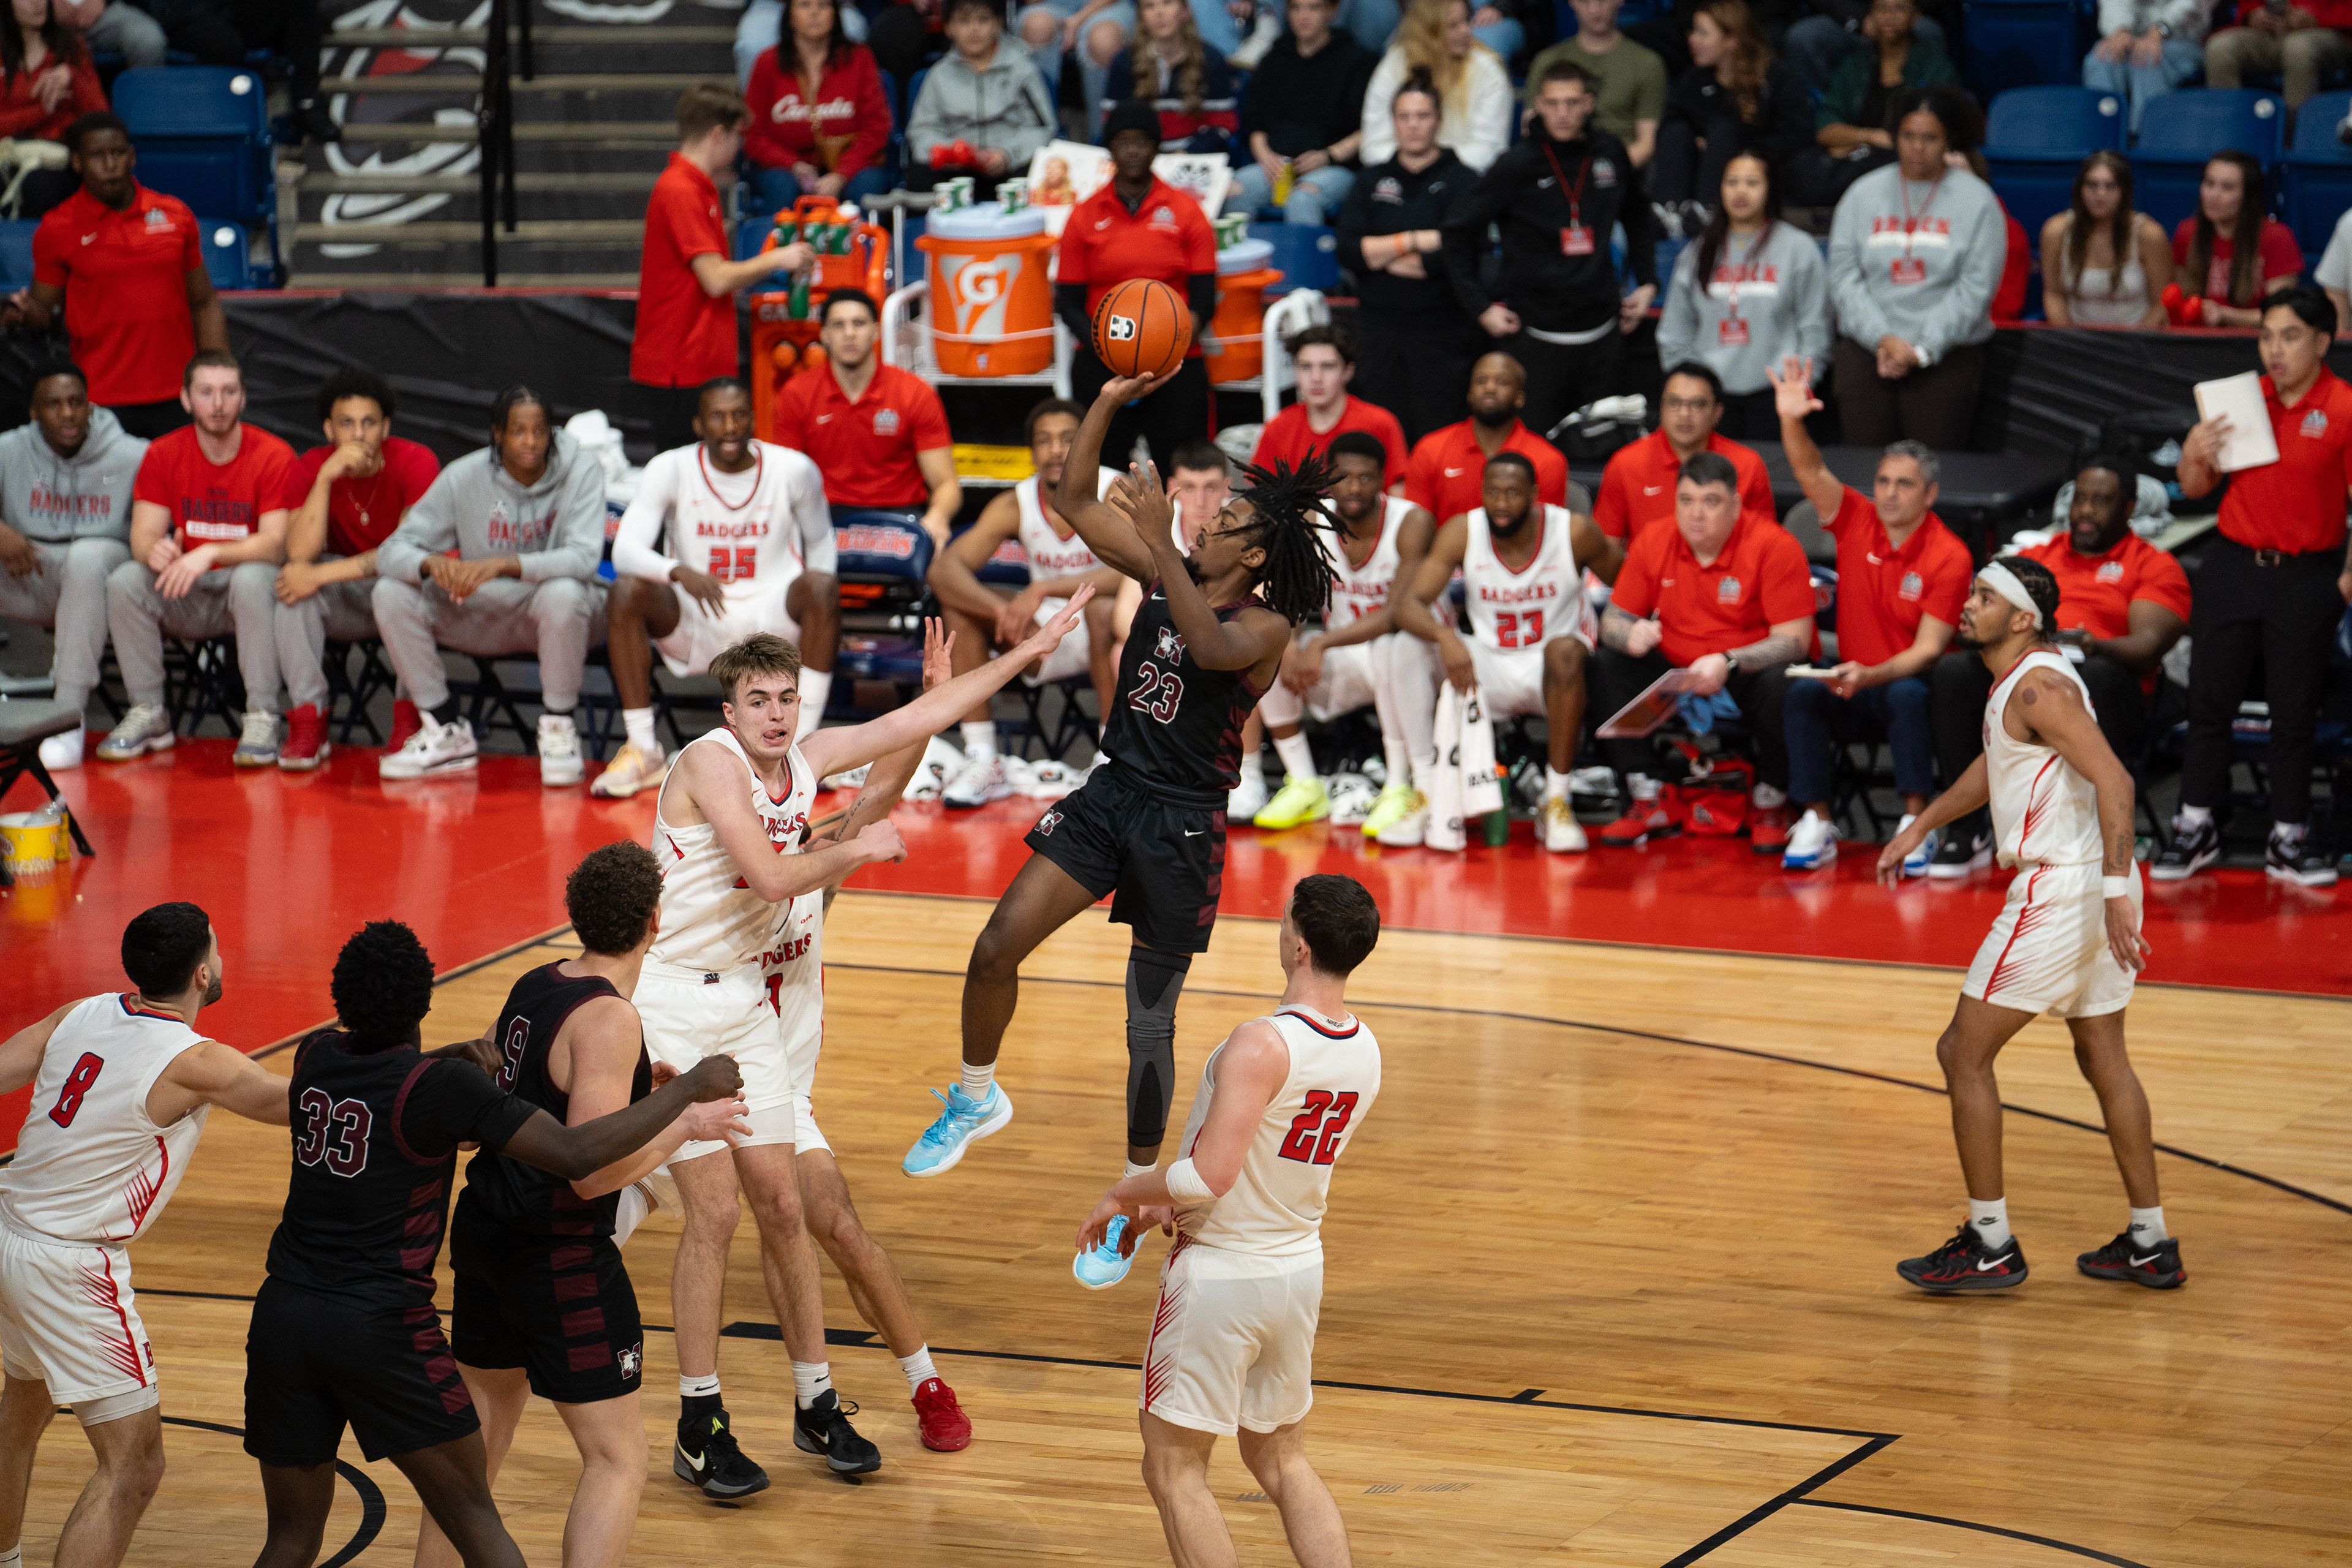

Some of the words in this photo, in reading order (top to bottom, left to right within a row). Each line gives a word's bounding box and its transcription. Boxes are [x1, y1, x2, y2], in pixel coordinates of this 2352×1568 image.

[959, 261, 1000, 304] G
[709, 546, 756, 580] 25
[1495, 609, 1544, 647] 23
[1128, 660, 1185, 725] 23
[48, 1051, 104, 1129] 8
[496, 1015, 530, 1095] 9
[297, 1087, 373, 1178] 33
[1278, 1089, 1359, 1165] 22
